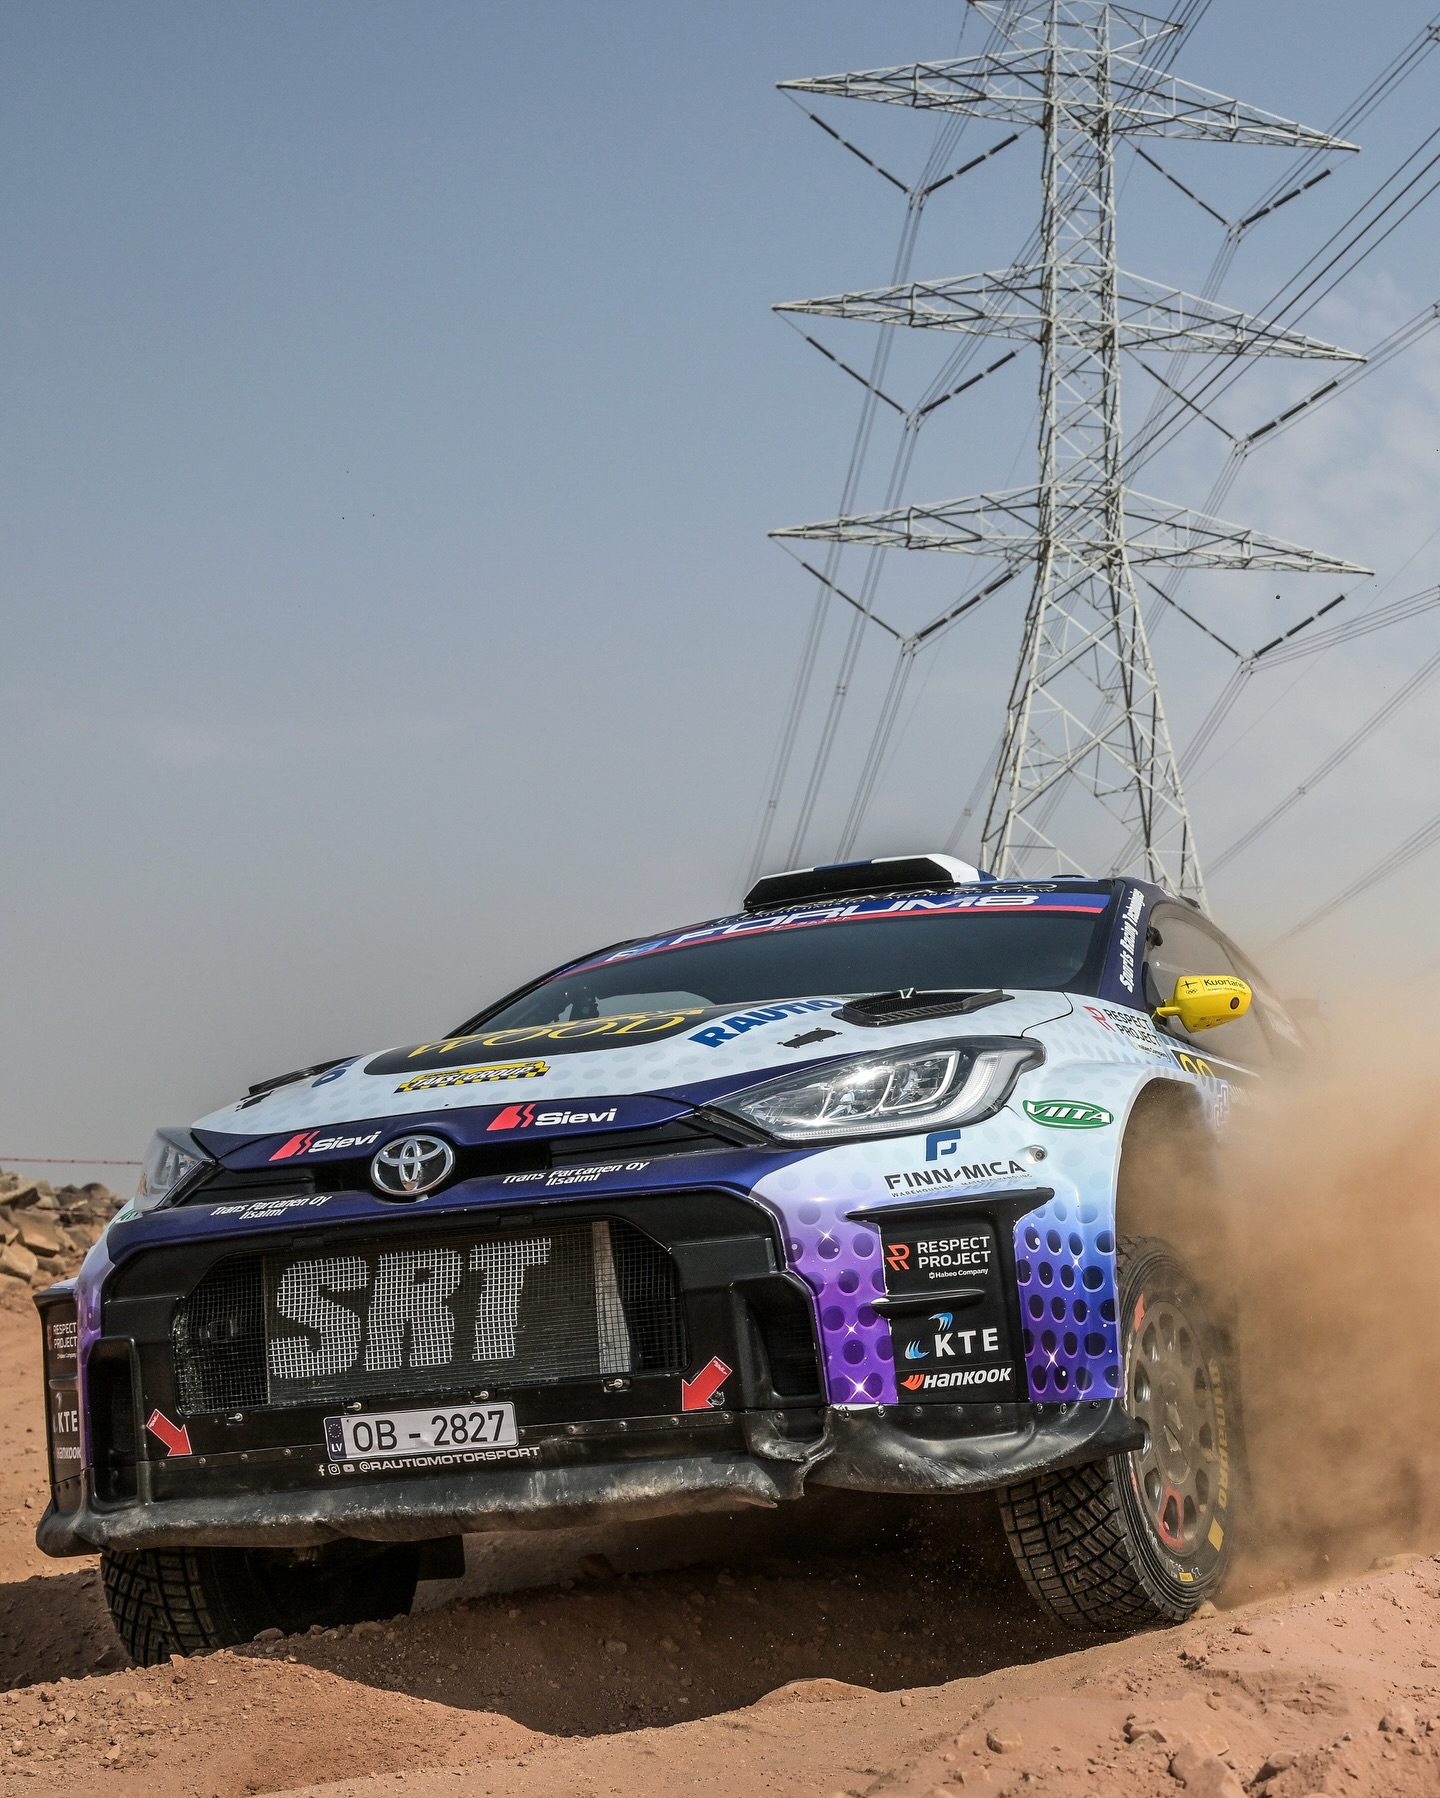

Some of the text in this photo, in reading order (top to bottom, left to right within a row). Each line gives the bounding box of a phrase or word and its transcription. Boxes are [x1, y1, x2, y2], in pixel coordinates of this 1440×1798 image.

[668, 895, 1040, 946] FORUM8
[1119, 921, 1139, 956] Racing
[1119, 950, 1135, 993] Sports
[687, 998, 843, 1049] RAUTIO
[1103, 1009, 1152, 1031] RESPECT
[407, 1014, 687, 1058] WOOD
[1115, 1022, 1162, 1048] PROJECT
[534, 1107, 618, 1127] Sievi
[1026, 1101, 1112, 1124] VIITA
[308, 1131, 382, 1153] Sievi
[502, 1172, 547, 1184] Trans
[626, 1161, 651, 1171] Oy
[210, 1205, 246, 1216] Trans
[308, 1196, 333, 1207] Oy
[917, 1236, 991, 1254] RESPECT
[918, 1250, 992, 1269] PROJECT
[935, 1268, 989, 1279] Habeo Company
[268, 1237, 552, 1379] SRT
[53, 1322, 77, 1336] RESPECT
[53, 1336, 78, 1350] PROJECT
[934, 1327, 999, 1358] KTE
[57, 1410, 79, 1433] KTE
[352, 1419, 398, 1452] OB
[431, 1409, 504, 1447] 2827
[331, 1443, 343, 1452] LV
[358, 1446, 541, 1473] @RAUTIOMOTORSPORT
